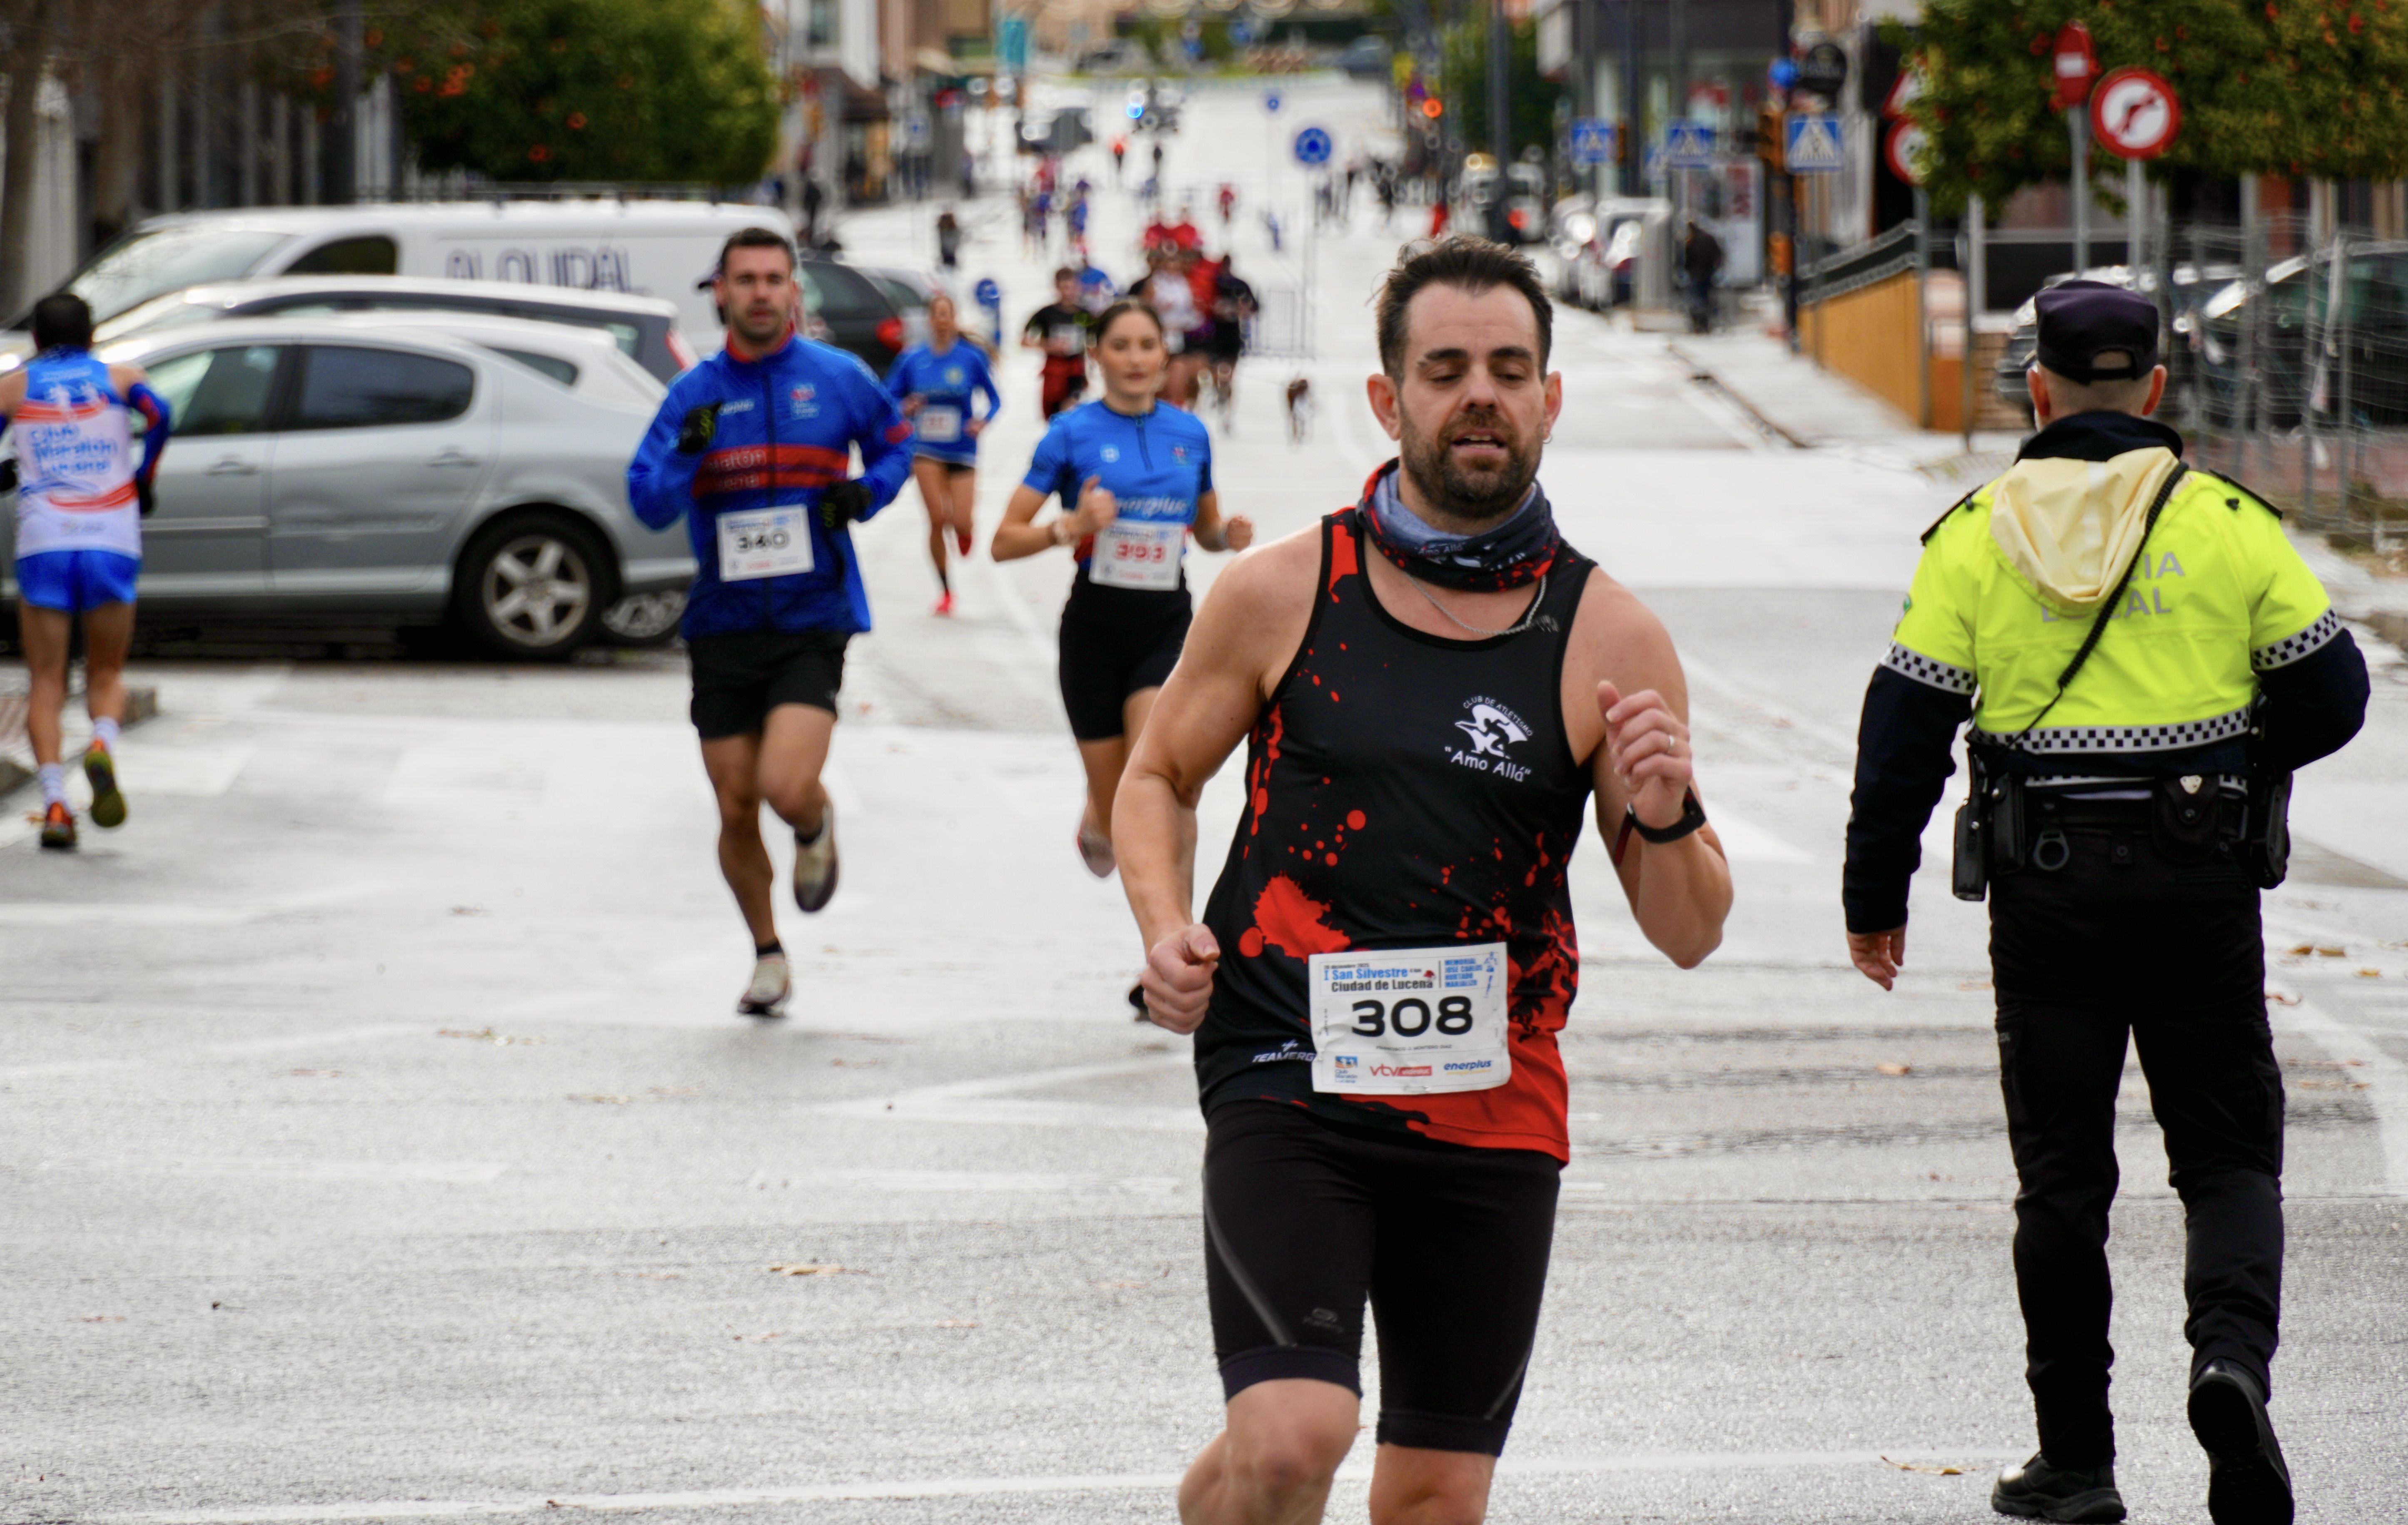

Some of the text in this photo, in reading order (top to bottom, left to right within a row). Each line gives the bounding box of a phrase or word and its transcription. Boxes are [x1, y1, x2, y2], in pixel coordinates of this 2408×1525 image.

[2042, 587, 2172, 623] LAL
[1463, 695, 1483, 708] CLUB
[1495, 704, 1533, 736] ATLETISMO
[1324, 969, 1329, 981] I
[1332, 969, 1353, 980] San
[1356, 967, 1408, 979] Silvestre
[1331, 979, 1433, 992] Ciudad de Lucena
[1352, 996, 1473, 1037] 308
[1444, 1060, 1492, 1071] enerplus
